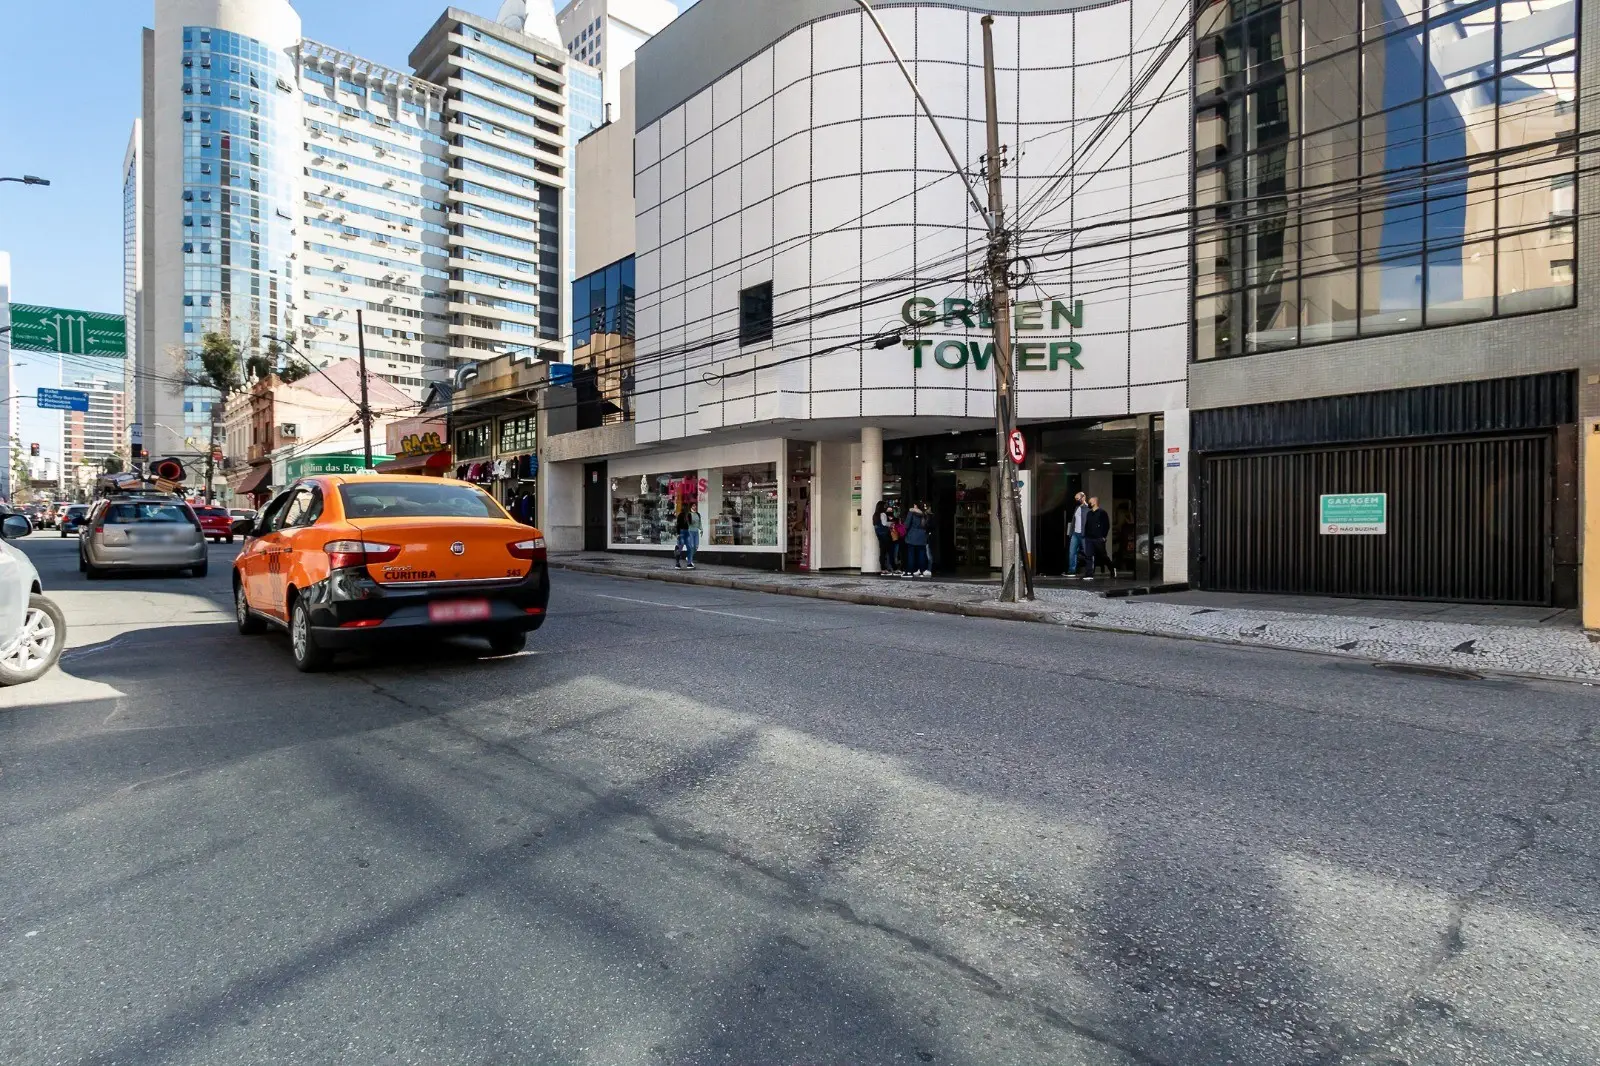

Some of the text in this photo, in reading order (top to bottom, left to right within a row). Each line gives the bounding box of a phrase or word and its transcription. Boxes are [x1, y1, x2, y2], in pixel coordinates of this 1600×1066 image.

[902, 339, 1085, 371] TOWER
[325, 463, 340, 472] das
[343, 463, 366, 472] Erva
[384, 570, 437, 580] CURITIBA
